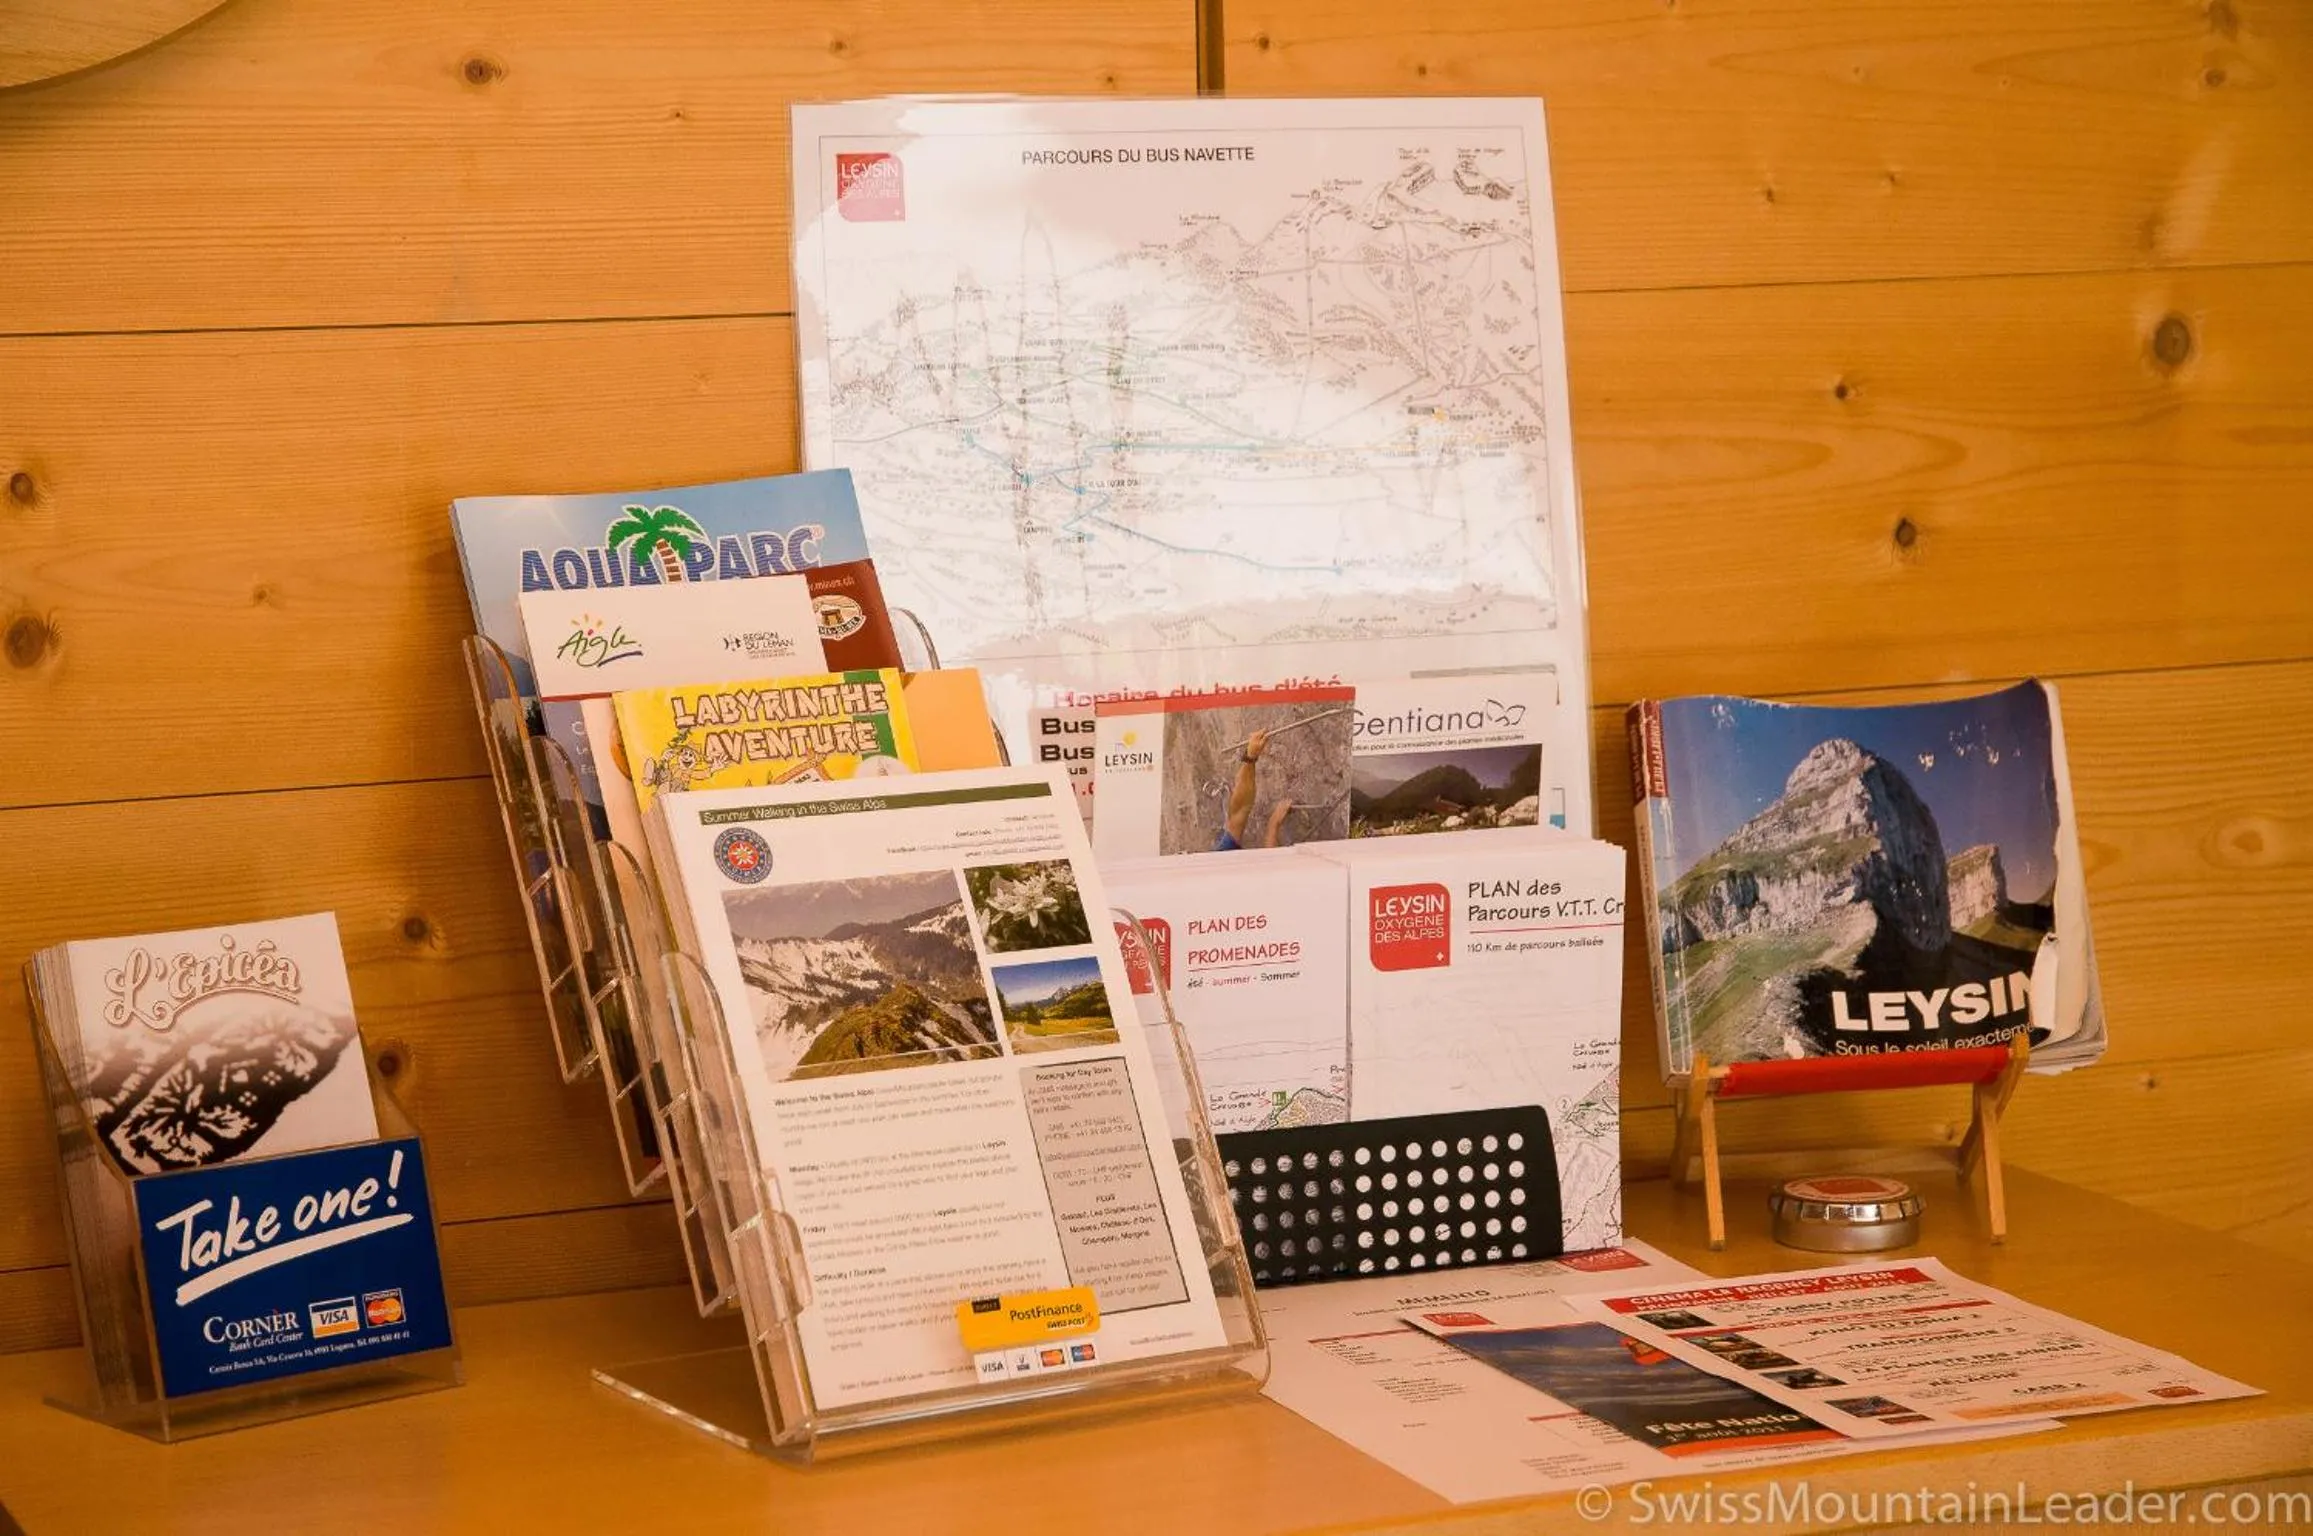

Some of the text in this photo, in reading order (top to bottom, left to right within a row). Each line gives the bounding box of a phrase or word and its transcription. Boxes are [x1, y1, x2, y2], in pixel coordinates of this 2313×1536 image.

[1022, 146, 1255, 166] PARCOURS DU BUS NAVETTE
[840, 161, 899, 180] LEYSIN
[671, 682, 889, 728] LABYRINTHE
[1052, 686, 1161, 708] Horaire
[1041, 718, 1095, 735] Bus
[1352, 707, 1484, 737] Gentiana
[705, 721, 879, 763] AVENTURE
[1041, 744, 1095, 761] Bus
[1105, 752, 1153, 767] LEYSIN
[703, 799, 888, 824] Summer Walking in the Swiss Alps
[1468, 880, 1562, 898] PLAN des
[1374, 894, 1445, 918] LEYSIN
[1468, 903, 1551, 922] Parcours
[1555, 900, 1598, 917] V.T.T.
[1188, 914, 1268, 935] PLAN DES
[1375, 914, 1445, 931] OXYGENE
[1375, 927, 1445, 944] DES ALPES
[1486, 942, 1503, 952] Km
[1504, 941, 1518, 951] de
[1519, 940, 1566, 953] parcours
[1568, 935, 1604, 949] balisés
[1188, 941, 1301, 965] PROMENADES
[1211, 976, 1251, 987] summer
[1260, 970, 1301, 982] Sommer
[1831, 971, 2032, 1031] LEYSIN
[1835, 1039, 1880, 1057] Sous
[1904, 1038, 1949, 1052] soleil
[156, 1150, 404, 1272] Take one!
[319, 1309, 350, 1326] VISA
[1010, 1303, 1083, 1322] PostFinance
[982, 1361, 1005, 1373] VISA
[1645, 1421, 1714, 1435] Fête
